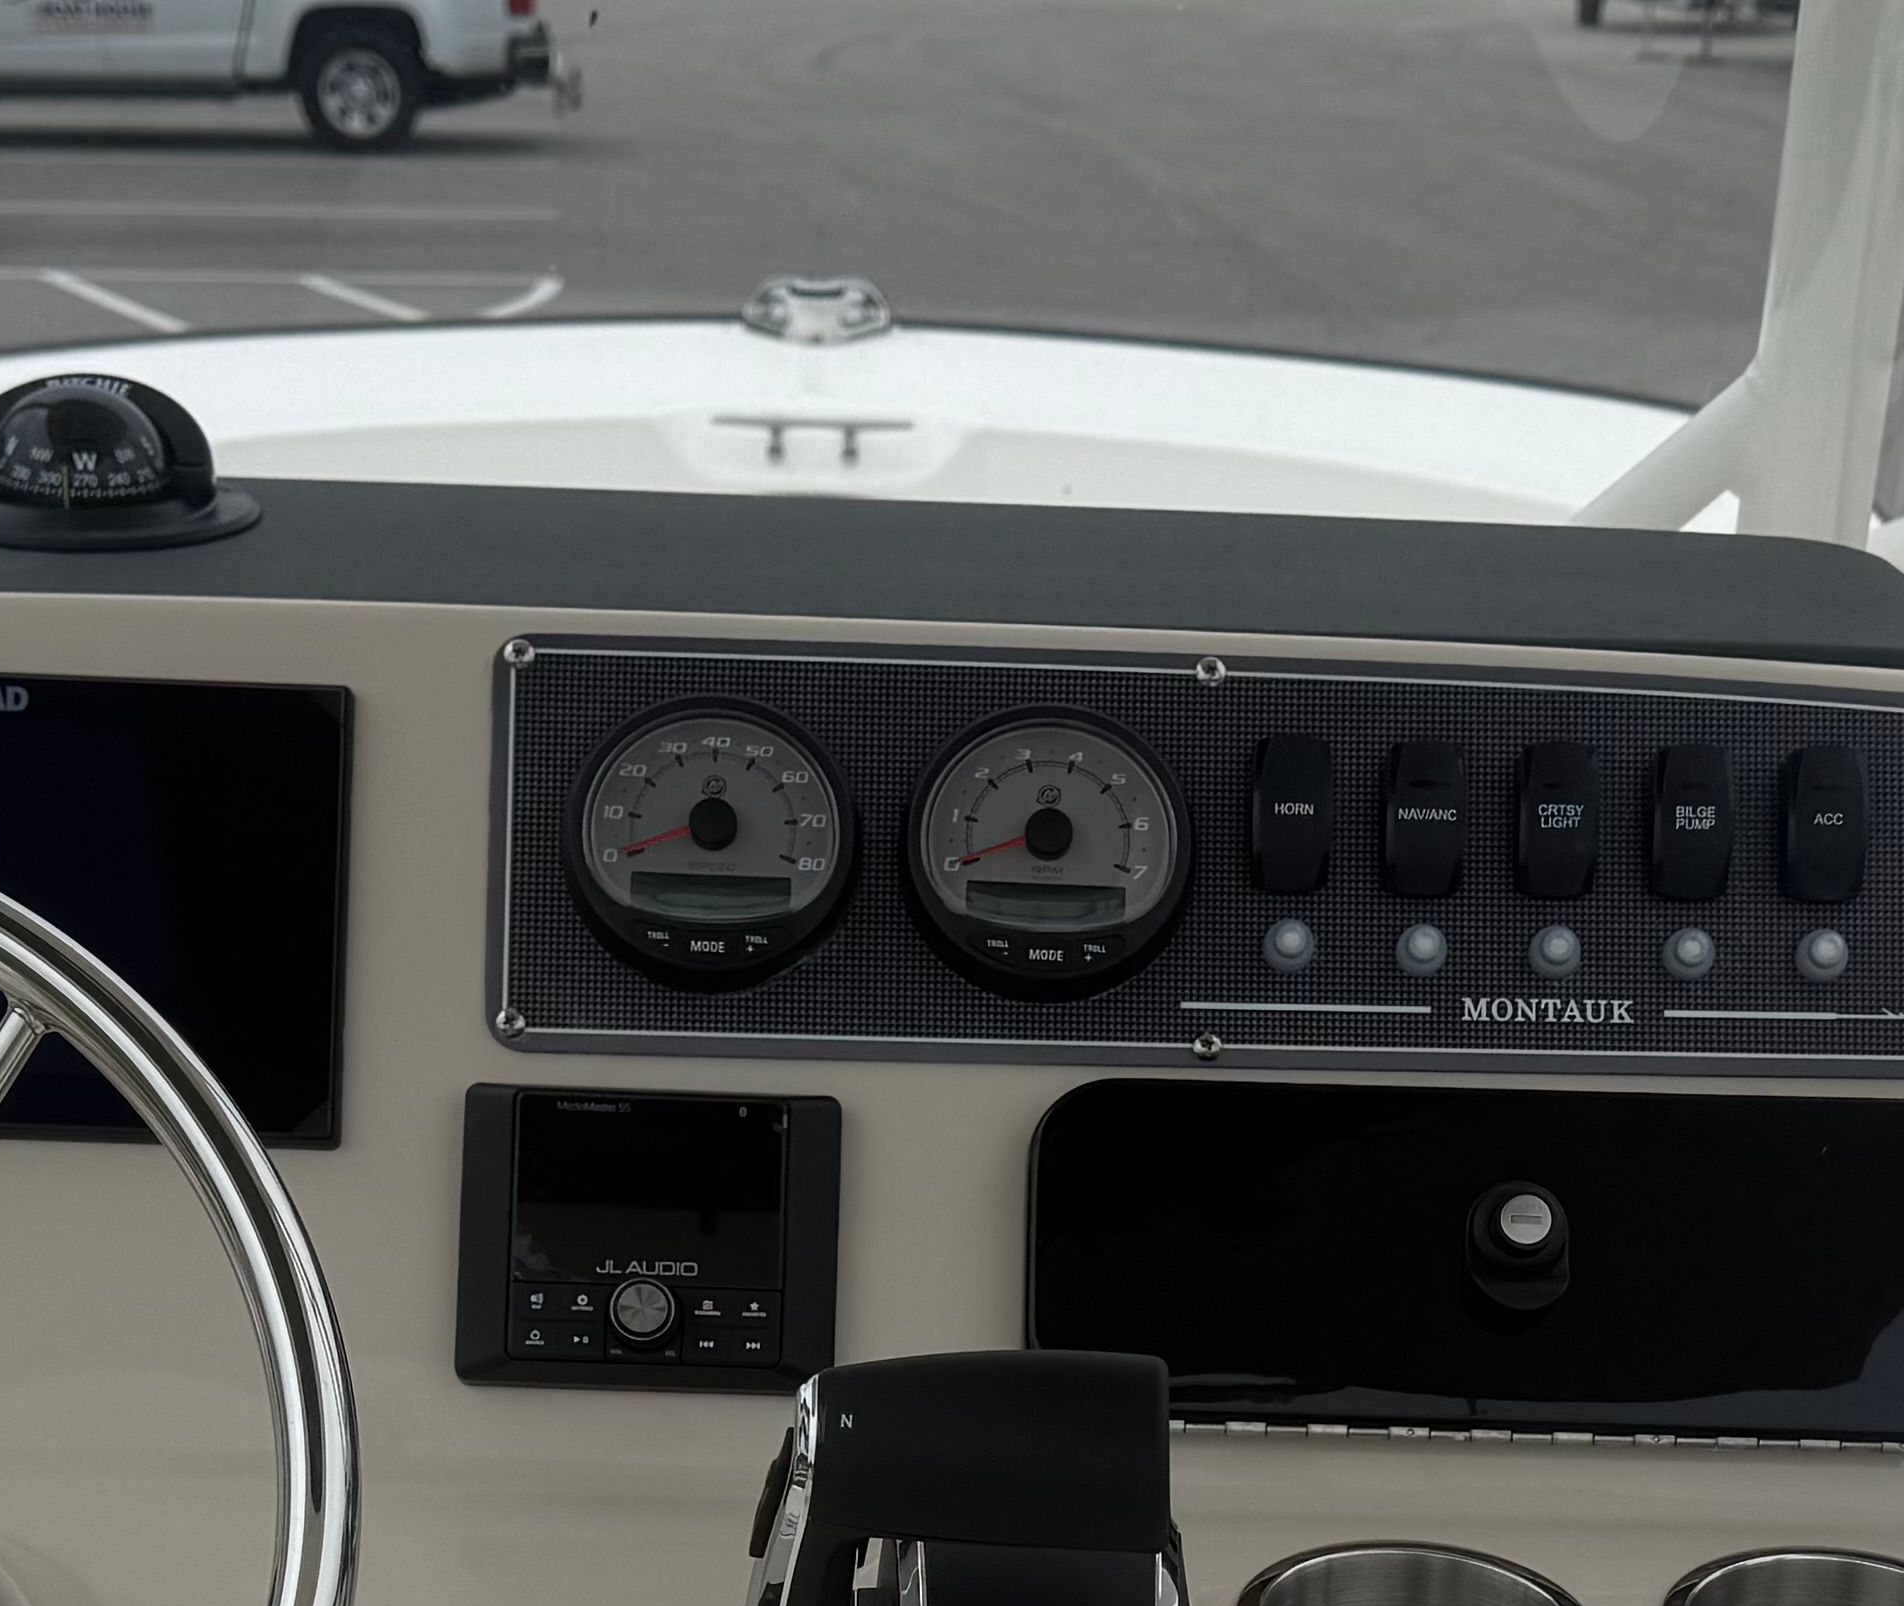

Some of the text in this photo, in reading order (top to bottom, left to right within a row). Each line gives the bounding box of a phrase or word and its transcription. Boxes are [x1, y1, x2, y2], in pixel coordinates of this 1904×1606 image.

[72, 452, 97, 471] W
[73, 473, 98, 486] 270
[658, 742, 688, 753] 30
[701, 737, 731, 748] 40
[744, 745, 774, 758] 50
[1015, 749, 1031, 760] 3
[1069, 751, 1083, 763] 4
[619, 764, 647, 777] 20
[782, 771, 809, 783] 60
[974, 768, 990, 779] 2
[1111, 774, 1127, 785] 5
[603, 805, 623, 819] 10
[952, 809, 959, 822] 1
[1274, 803, 1314, 816] HORN
[1398, 808, 1457, 821] NAV/ANC
[1538, 804, 1584, 816] CRTSY
[1675, 806, 1716, 818] BILGE
[800, 814, 827, 828] 70
[1133, 817, 1150, 831] 6
[1540, 816, 1582, 829] LIGHT
[1675, 818, 1716, 830] PUMP
[1814, 813, 1844, 826] ACC
[603, 848, 618, 862] 0
[798, 858, 826, 872] 80
[1132, 866, 1148, 880] 7
[647, 931, 768, 953] TROLL MODE TROLL
[987, 939, 1106, 962] TROLL MODE TROLL
[1461, 997, 1635, 1024] MONTAUK
[596, 1259, 698, 1276] JL AUDIO
[840, 1413, 853, 1429] N
